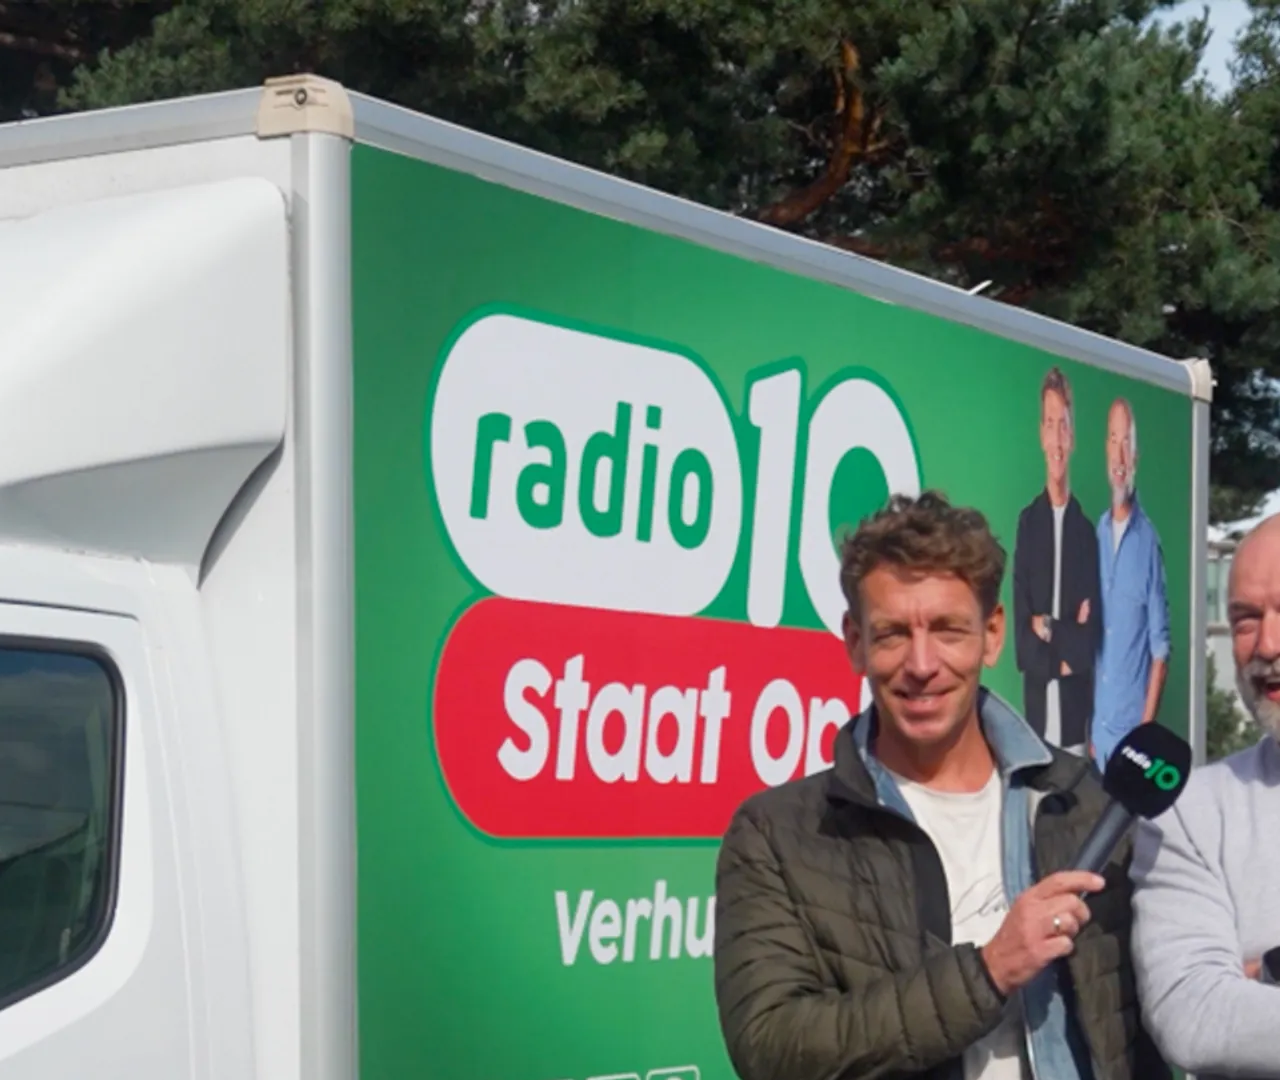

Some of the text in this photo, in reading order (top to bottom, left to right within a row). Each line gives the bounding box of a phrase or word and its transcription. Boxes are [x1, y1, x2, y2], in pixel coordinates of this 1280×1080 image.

[469, 368, 921, 641] radio 10
[496, 653, 873, 787] Staat Op
[1144, 758, 1181, 791] 10
[554, 879, 717, 966] Verhu
